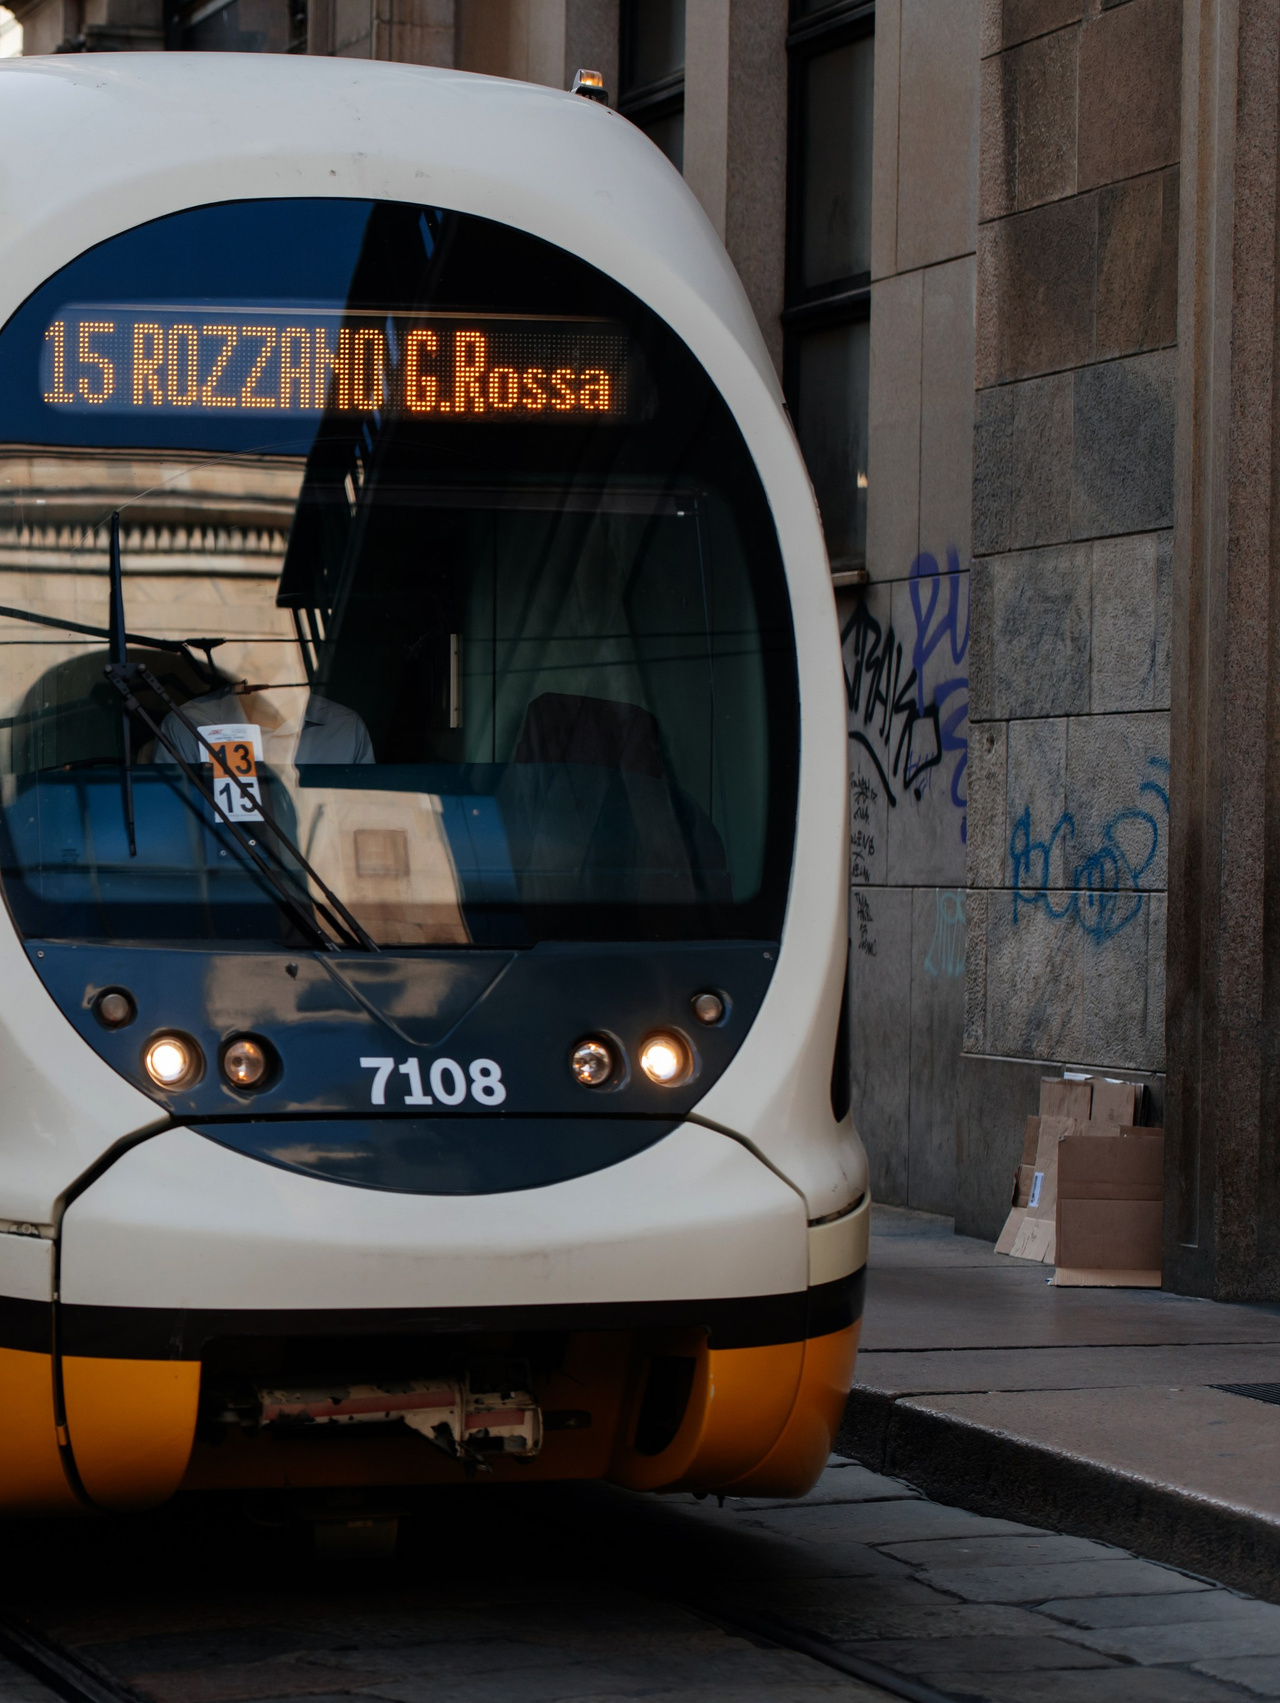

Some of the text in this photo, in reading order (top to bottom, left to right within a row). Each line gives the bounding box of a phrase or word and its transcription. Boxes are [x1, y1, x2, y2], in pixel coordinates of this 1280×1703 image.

[44, 320, 611, 413] 15 ROZZANO G.Rossa
[215, 743, 253, 775] 13
[219, 782, 257, 813] 15
[359, 1057, 507, 1106] 7108
